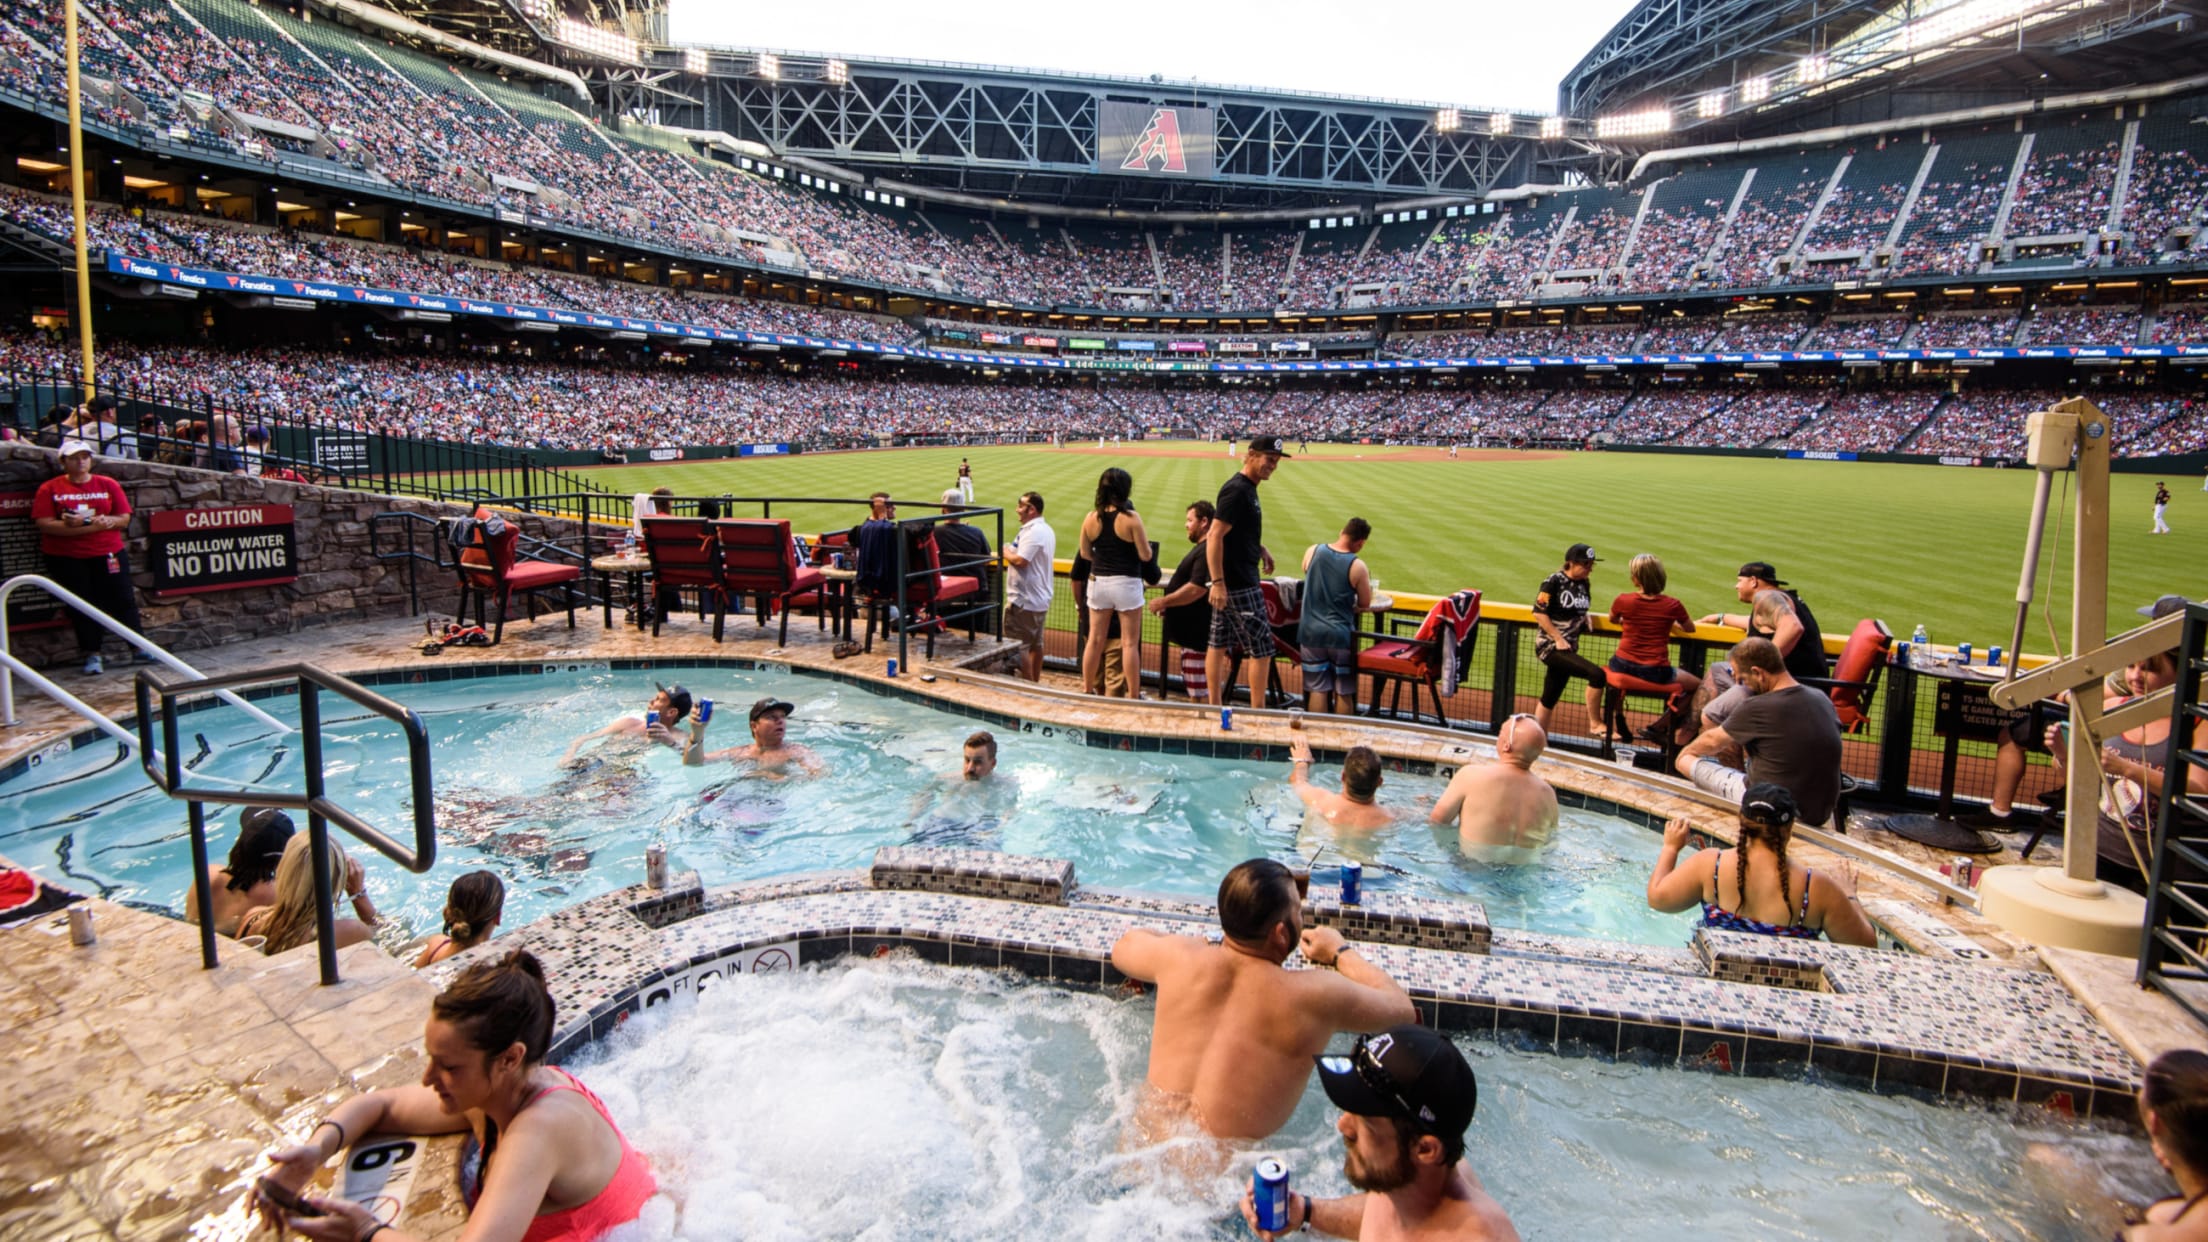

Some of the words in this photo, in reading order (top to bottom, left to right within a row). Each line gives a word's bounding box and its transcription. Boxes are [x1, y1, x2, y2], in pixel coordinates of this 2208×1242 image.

[131, 263, 158, 276] Fanatics
[240, 281, 275, 292] Fanatics
[305, 286, 338, 297] Fanatics
[365, 292, 395, 303] Fanatics
[185, 509, 263, 528] CAUTION
[166, 538, 234, 555] SHALLOW
[238, 534, 285, 549] WATER
[168, 556, 201, 578] NO
[210, 548, 286, 574] DIVING
[1023, 722, 1033, 733] 4
[1042, 726, 1054, 738] 6
[673, 975, 690, 994] FT
[727, 960, 742, 977] IN
